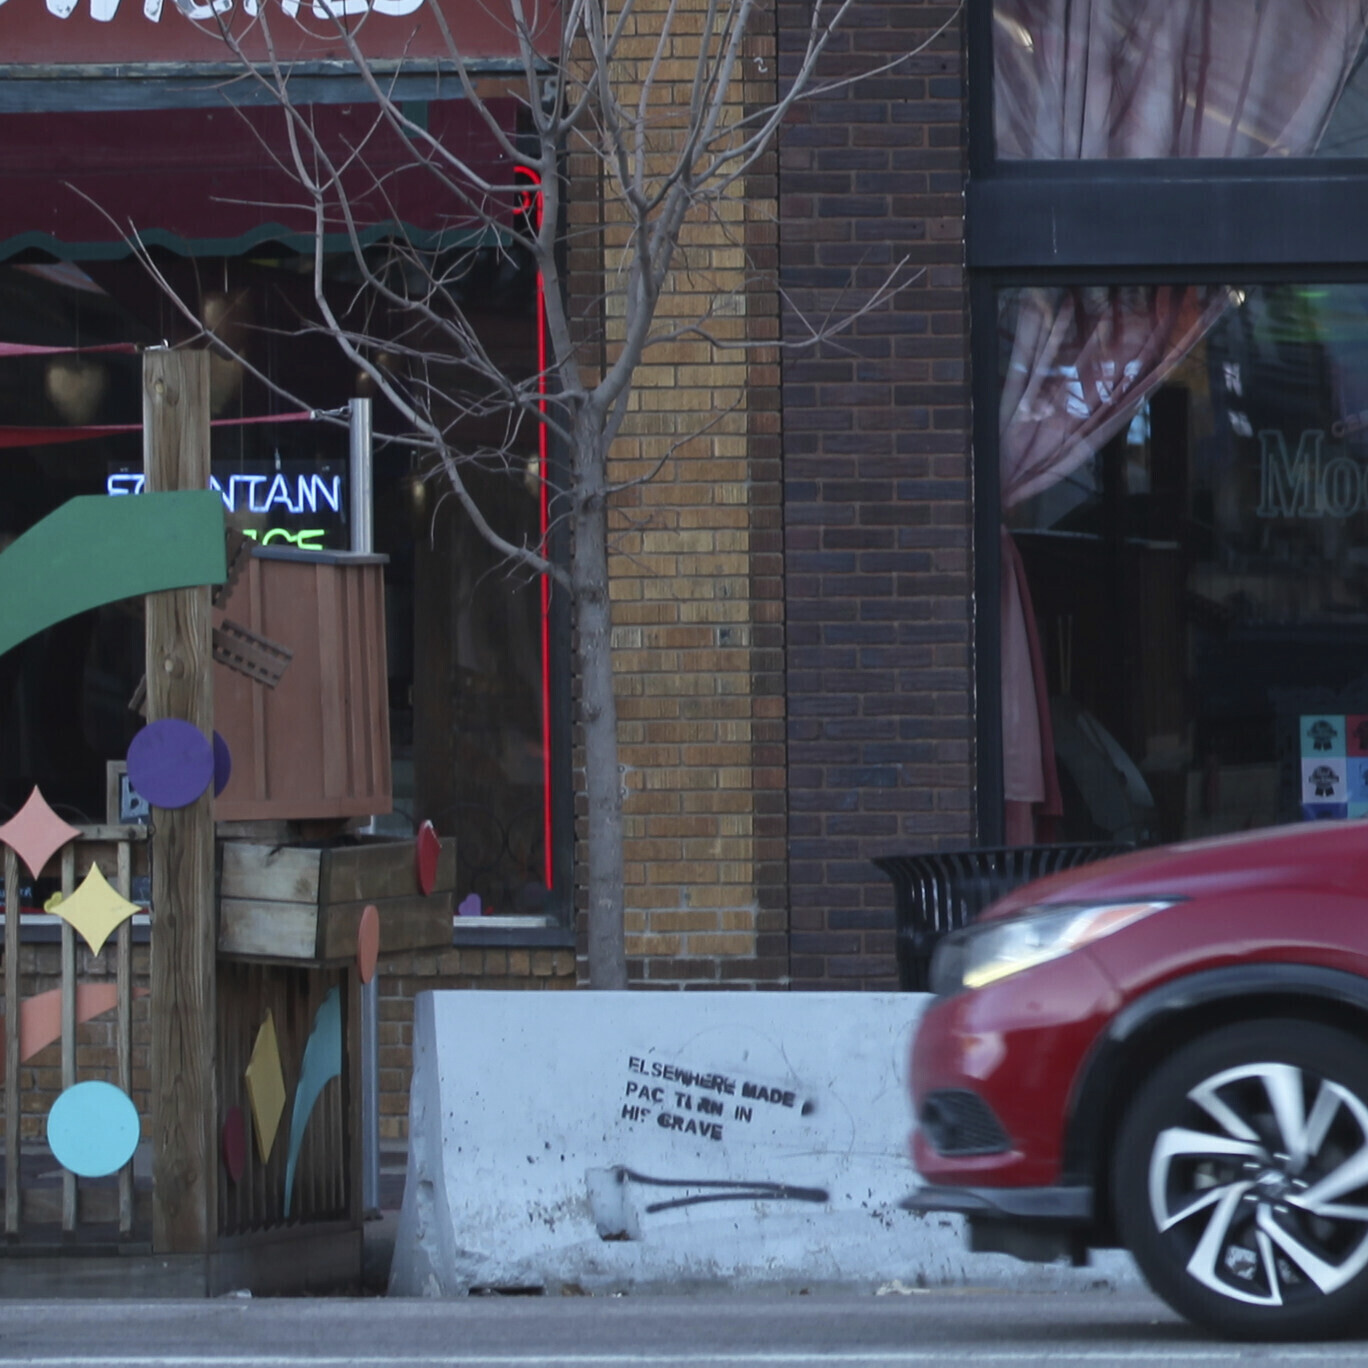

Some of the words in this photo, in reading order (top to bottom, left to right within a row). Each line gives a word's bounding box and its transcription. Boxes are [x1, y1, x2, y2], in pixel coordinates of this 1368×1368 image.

[107, 474, 341, 513] FNTAIN
[625, 1080, 665, 1104] PAC
[734, 1105, 753, 1124] IN
[628, 1055, 737, 1096] ELSEWHERE
[741, 1081, 797, 1108] MADE
[656, 1112, 724, 1142] GRAVE
